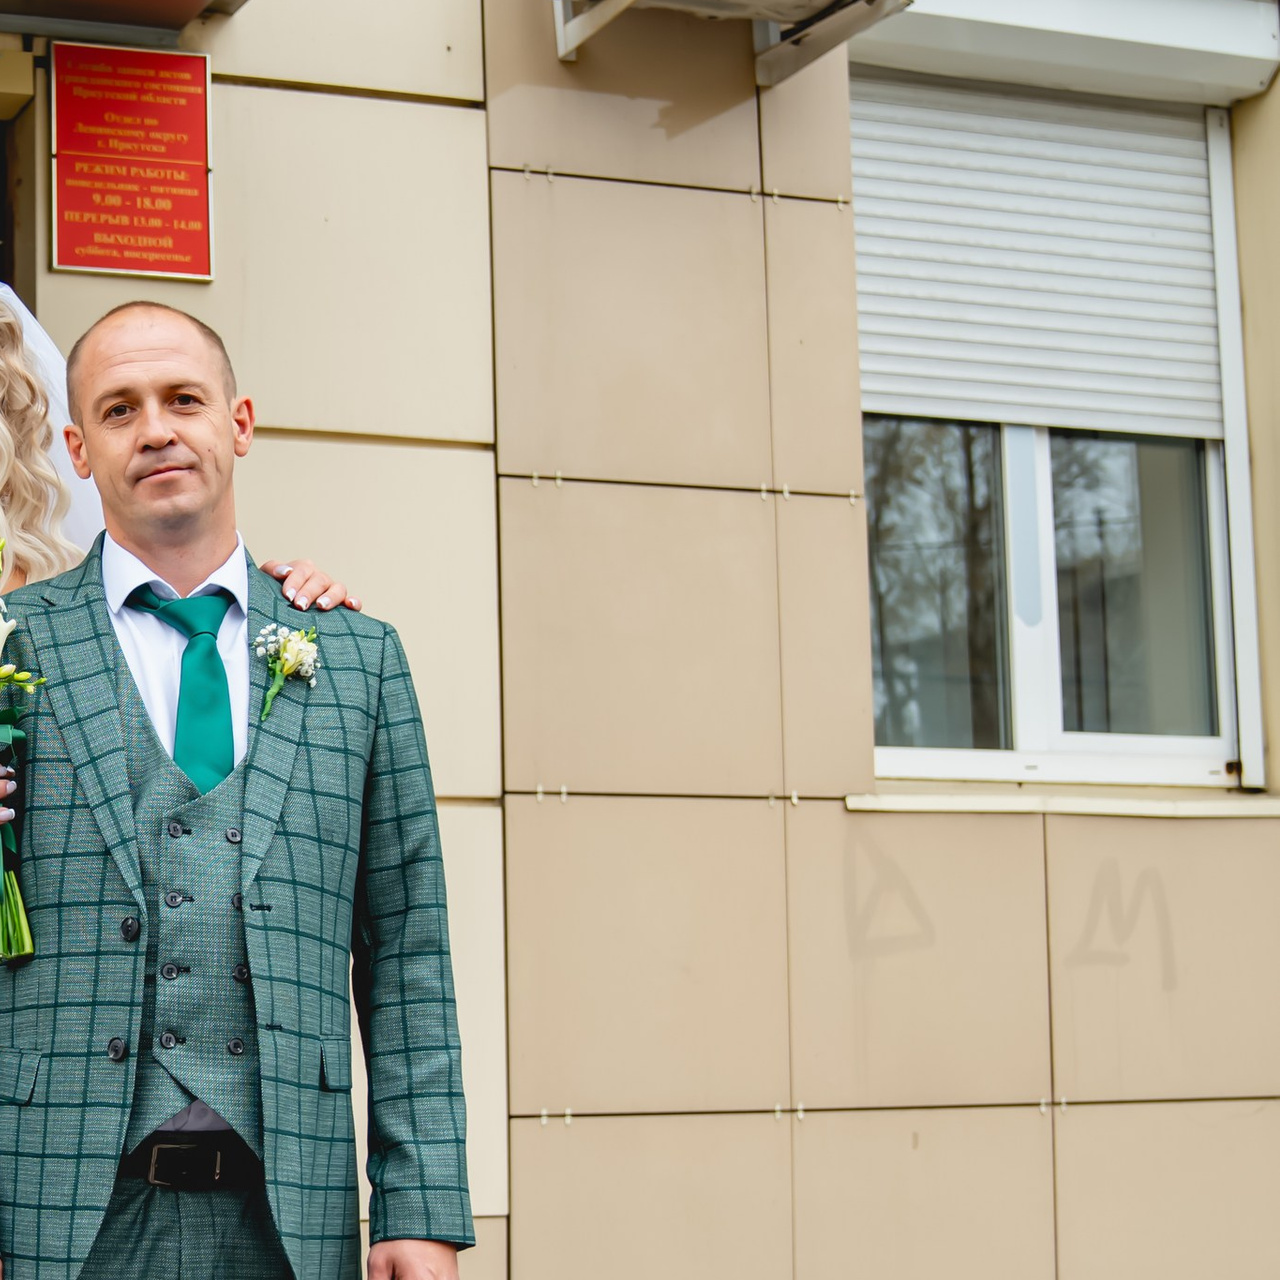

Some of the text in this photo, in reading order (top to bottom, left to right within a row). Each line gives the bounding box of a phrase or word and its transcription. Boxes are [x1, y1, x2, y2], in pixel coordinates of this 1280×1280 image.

[75, 162, 127, 177] РЕЖИМ
[92, 194, 121, 207] 9.00
[136, 197, 172, 211] 18.00
[64, 211, 130, 226] ПЕРЕРЫВ
[133, 216, 162, 229] 13.00
[173, 219, 203, 232] 14.00
[93, 233, 174, 250] ВЫХОДНОЙ
